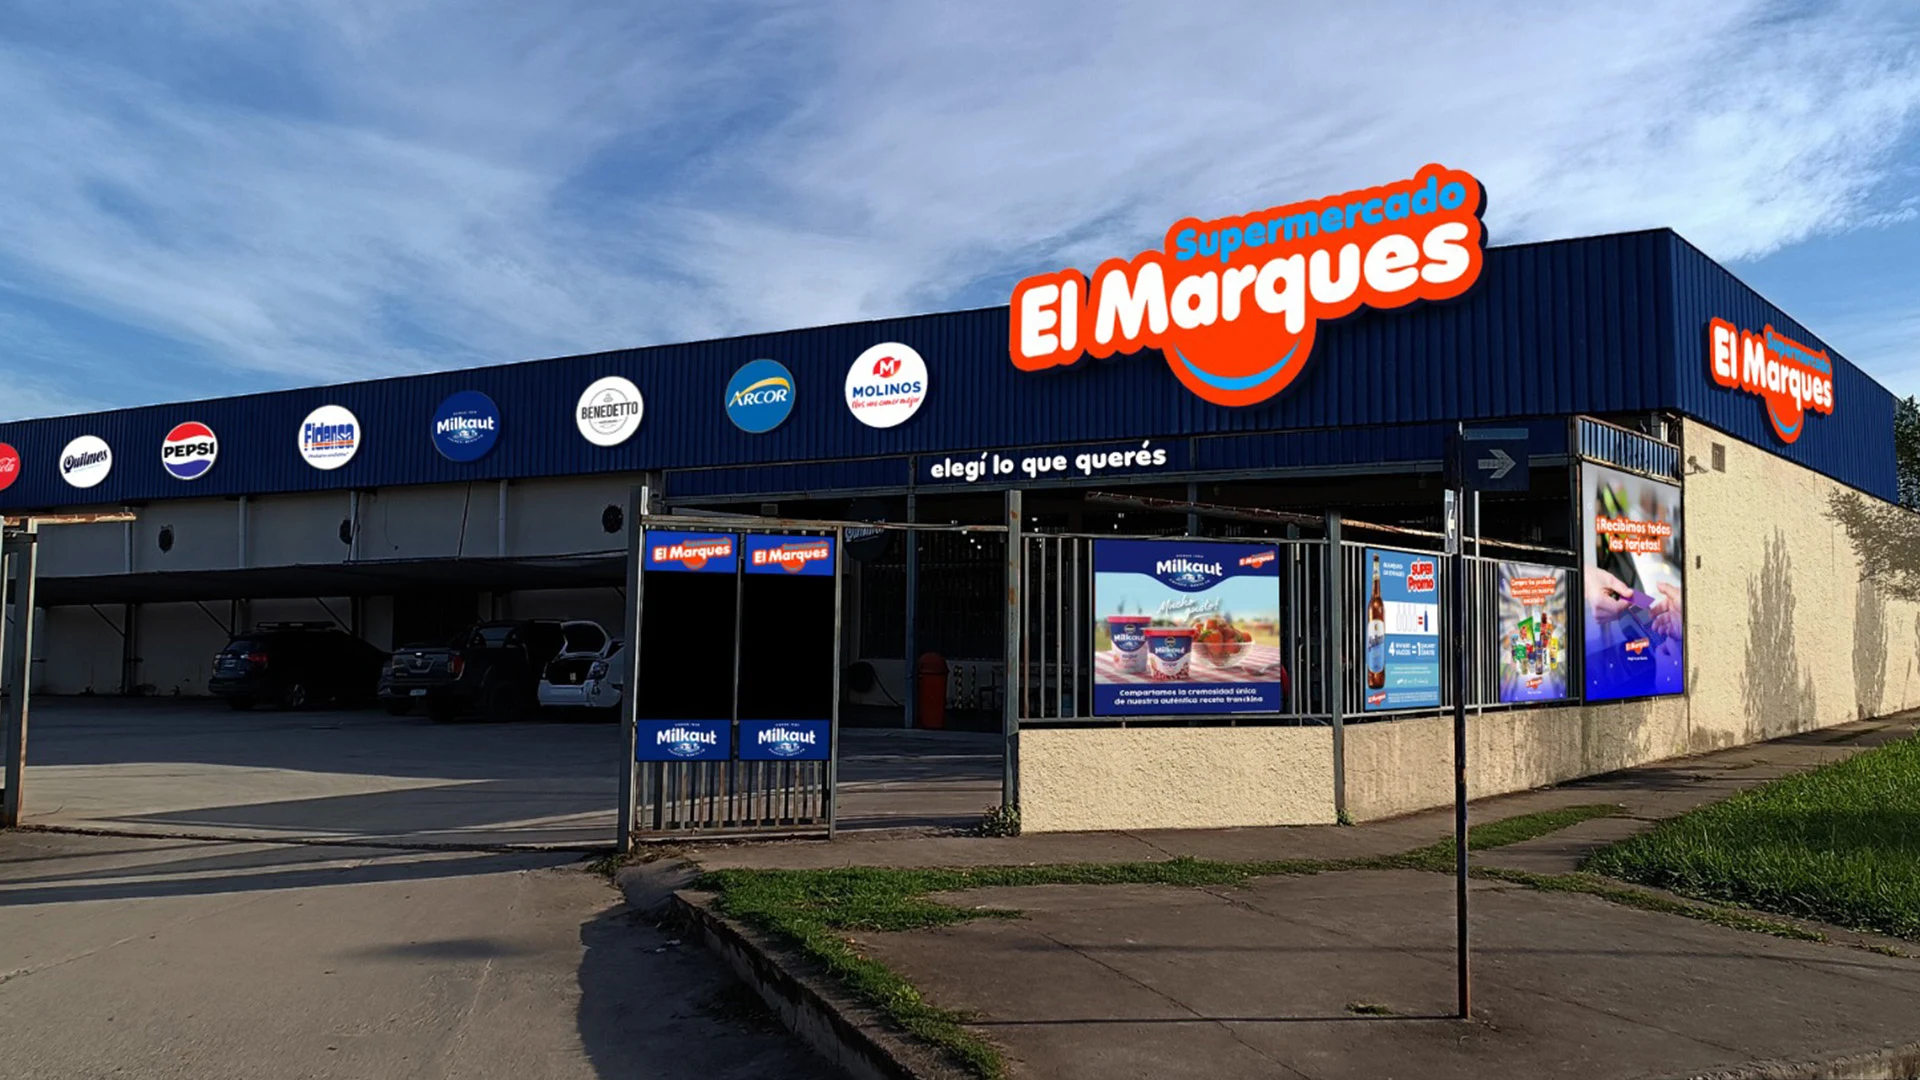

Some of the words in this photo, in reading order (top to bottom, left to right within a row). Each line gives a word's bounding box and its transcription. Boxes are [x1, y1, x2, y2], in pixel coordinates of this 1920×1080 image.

[1176, 175, 1466, 263] Supermercado
[1021, 280, 1077, 358] El
[1095, 222, 1470, 344] Marques
[1714, 326, 1737, 379] El
[1743, 338, 1832, 411] Marques
[729, 389, 787, 408] ARCOR
[852, 381, 921, 398] MOLINOS
[581, 401, 638, 420] BENEDETTO
[437, 416, 495, 435] Milkaut
[304, 422, 354, 451] Fidensa
[164, 442, 215, 458] PEPSI
[63, 449, 108, 474] Quilmes
[931, 452, 987, 482] elegí
[993, 454, 1014, 475] lo
[1021, 455, 1067, 478] que
[1075, 440, 1167, 476] querés
[1596, 517, 1646, 534] ¡Recibimos
[1648, 522, 1671, 534] todas
[655, 547, 667, 561] El
[669, 545, 731, 559] Marques
[1609, 536, 1623, 550] las
[1625, 536, 1660, 554] tarjetas!
[755, 551, 766, 563] El
[768, 548, 829, 563] Marques
[1156, 559, 1222, 576] Milkaut
[1408, 576, 1434, 591] Promo
[1388, 641, 1395, 656] 4
[1119, 689, 1176, 697] Compartamos
[1188, 688, 1234, 696] cremosidad
[656, 727, 717, 745] Milkaut
[758, 727, 816, 744] Milkaut
